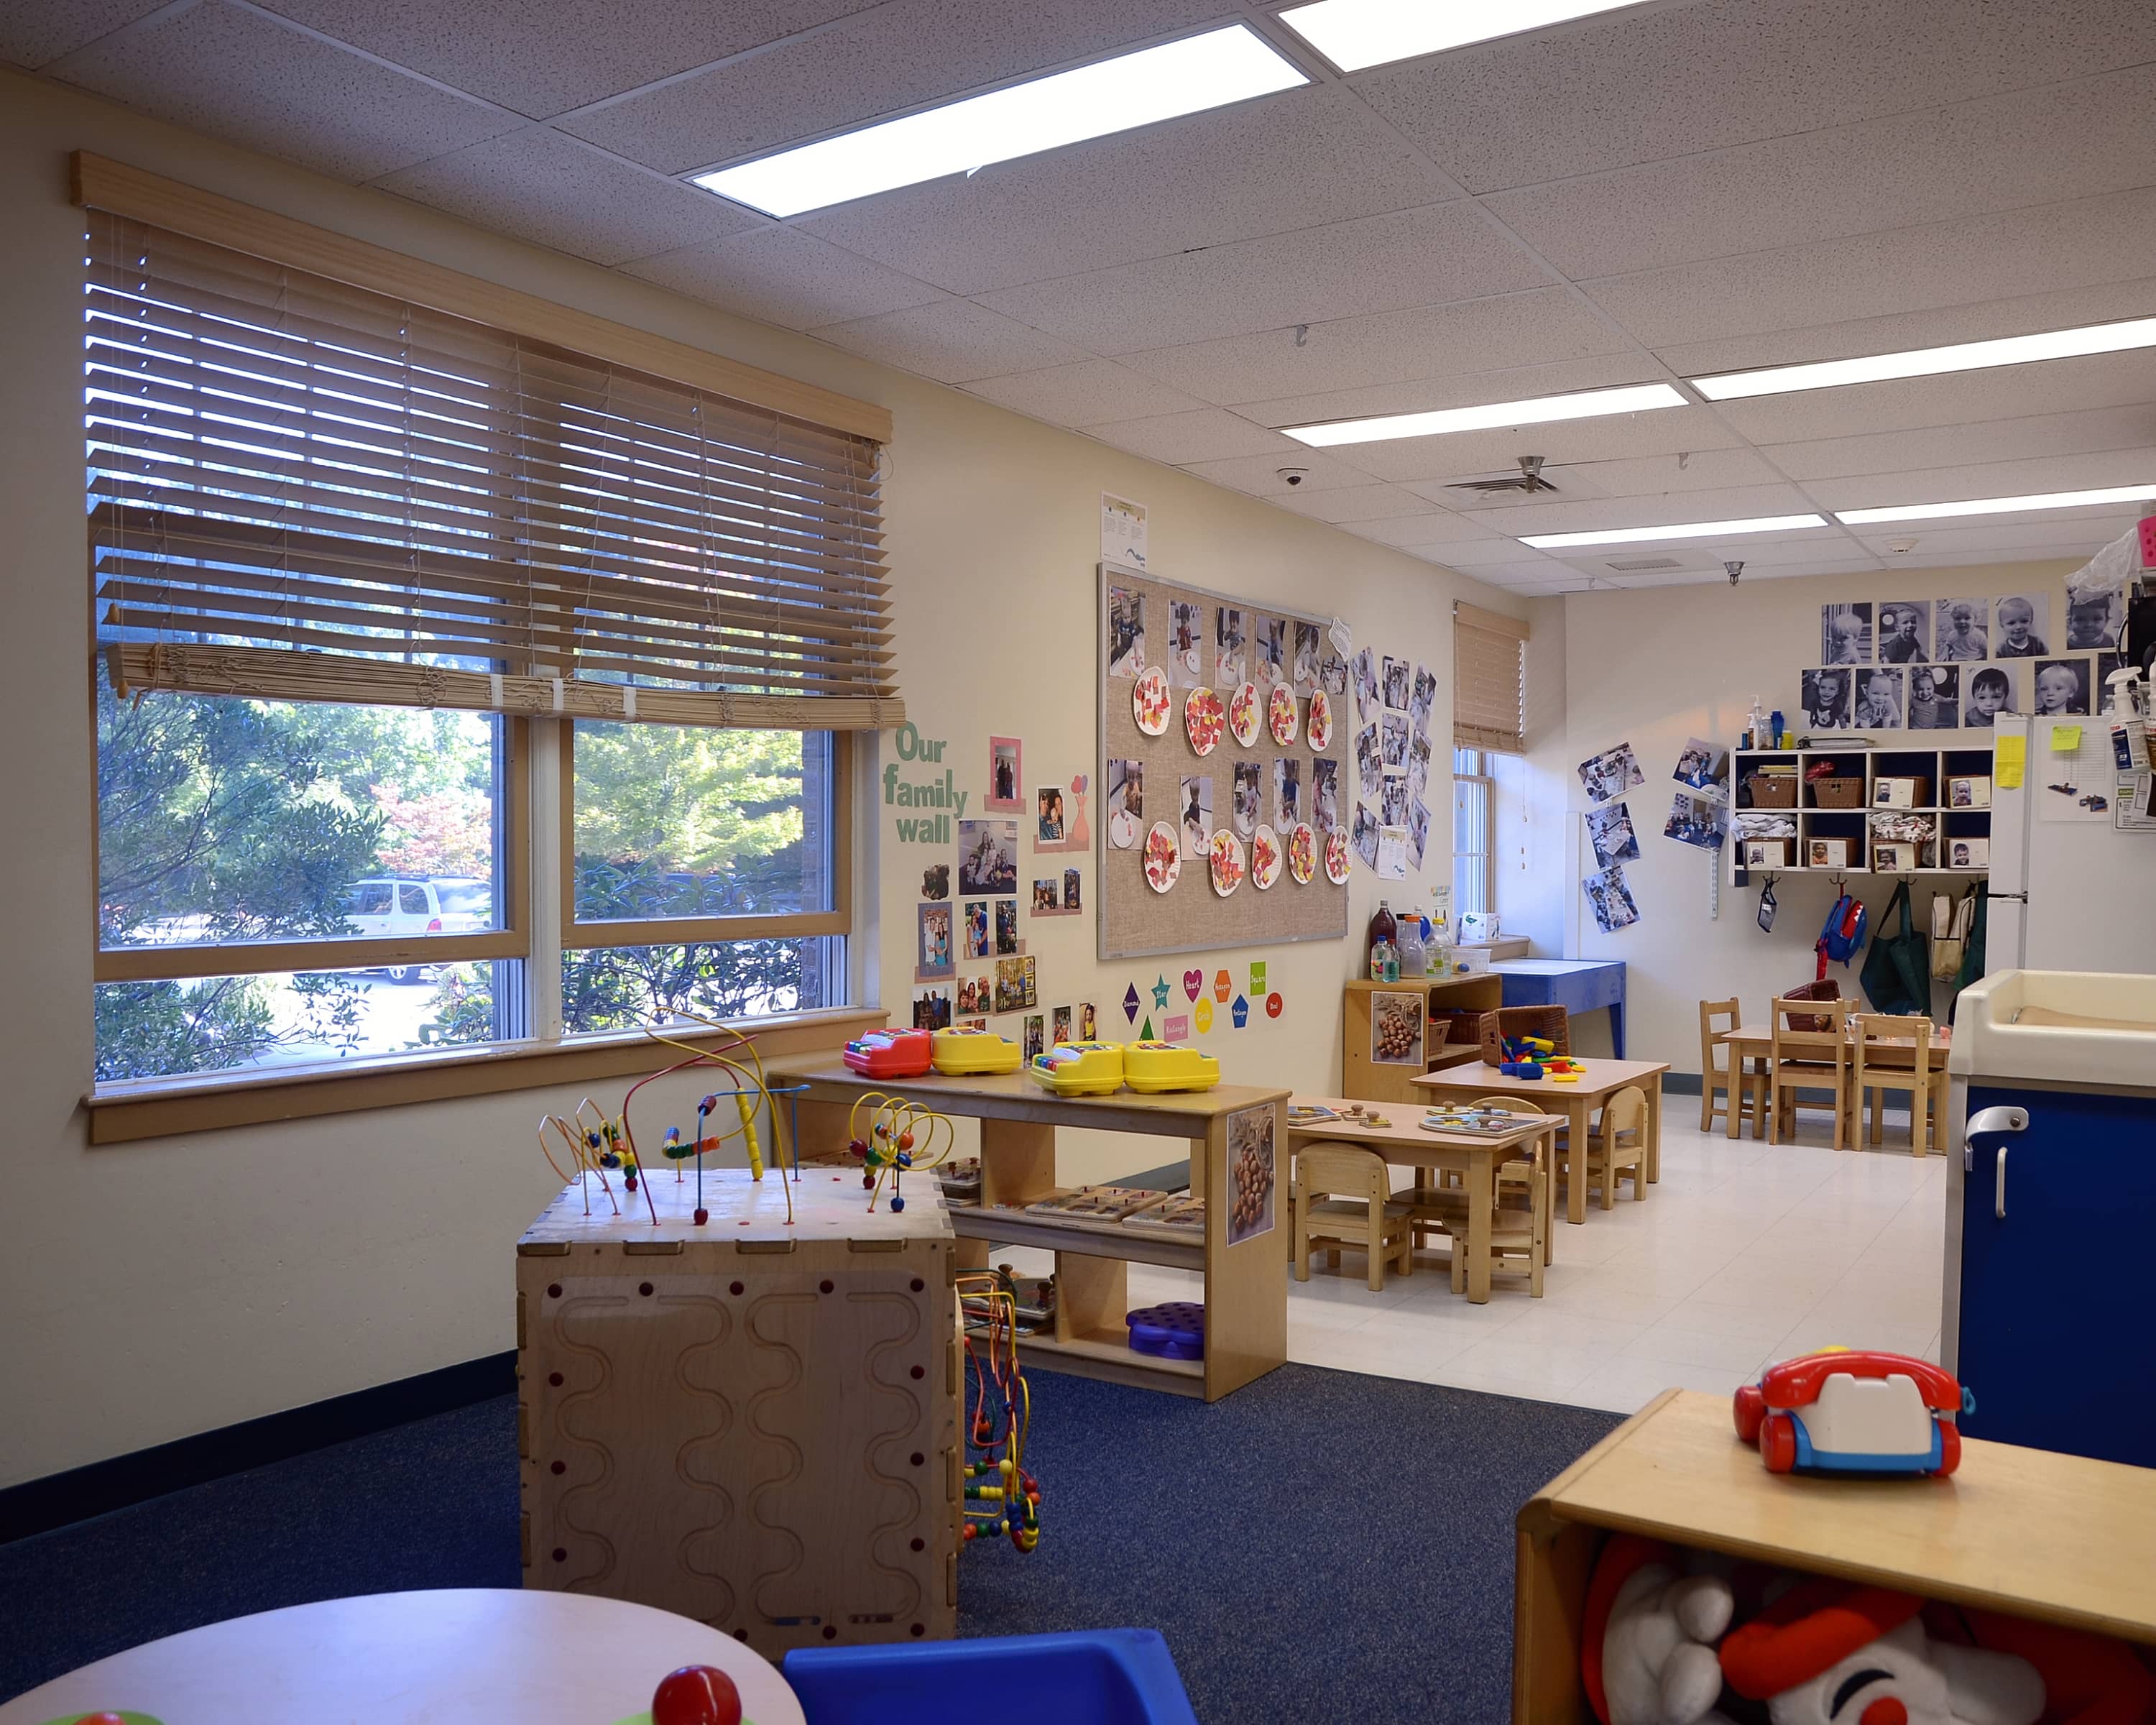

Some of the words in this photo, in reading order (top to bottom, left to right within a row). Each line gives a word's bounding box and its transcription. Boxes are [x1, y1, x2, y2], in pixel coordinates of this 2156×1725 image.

[895, 721, 947, 763] Our
[883, 763, 968, 819] family
[895, 815, 950, 845] wall
[1156, 990, 1167, 999] Star
[1185, 978, 1199, 990] Heart
